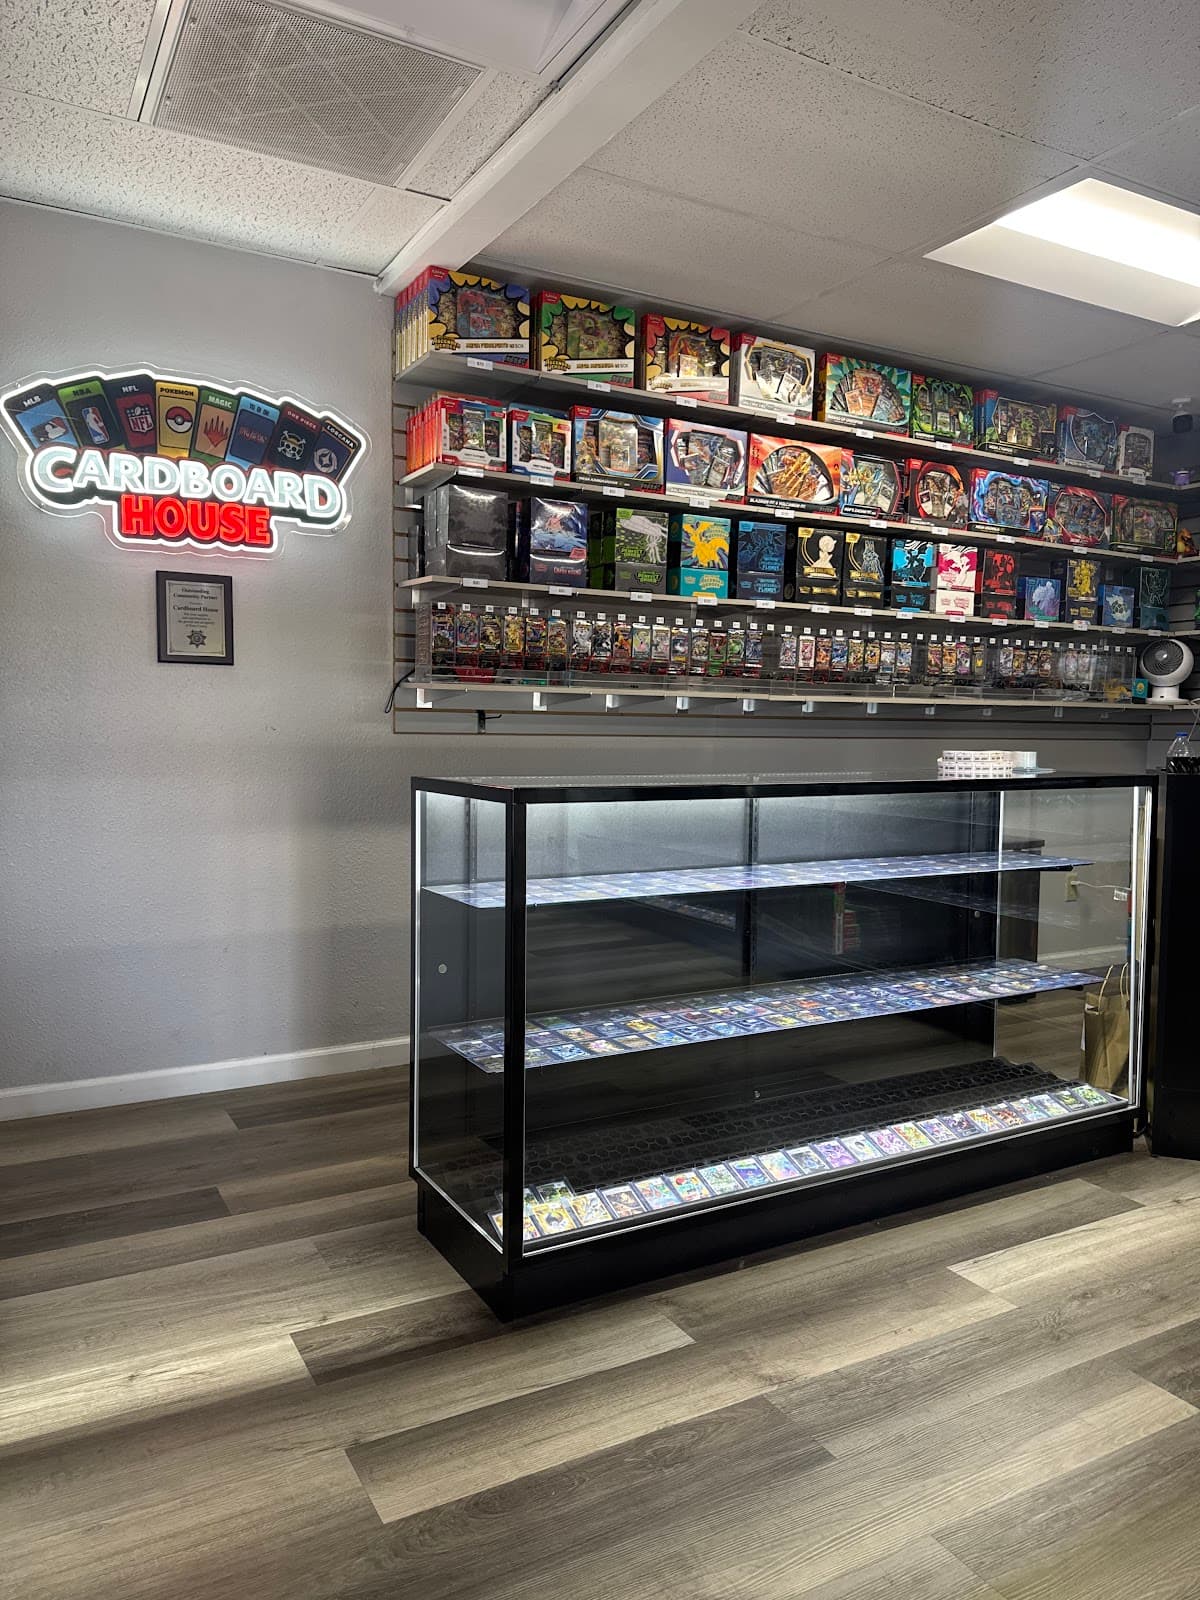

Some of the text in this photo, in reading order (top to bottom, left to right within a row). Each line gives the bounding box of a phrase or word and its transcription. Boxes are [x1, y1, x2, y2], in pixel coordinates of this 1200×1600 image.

[71, 387, 92, 397] NBA
[121, 385, 139, 393] NFL
[159, 387, 194, 397] POKEMON
[23, 395, 41, 408] MLB
[208, 395, 233, 409] MAGIC
[129, 414, 154, 433] NFL
[287, 410, 300, 421] ONE
[301, 416, 317, 430] PIECE
[326, 424, 355, 449] LORCANA
[33, 446, 341, 518] CARDBOARD
[121, 493, 271, 545] HOUSE
